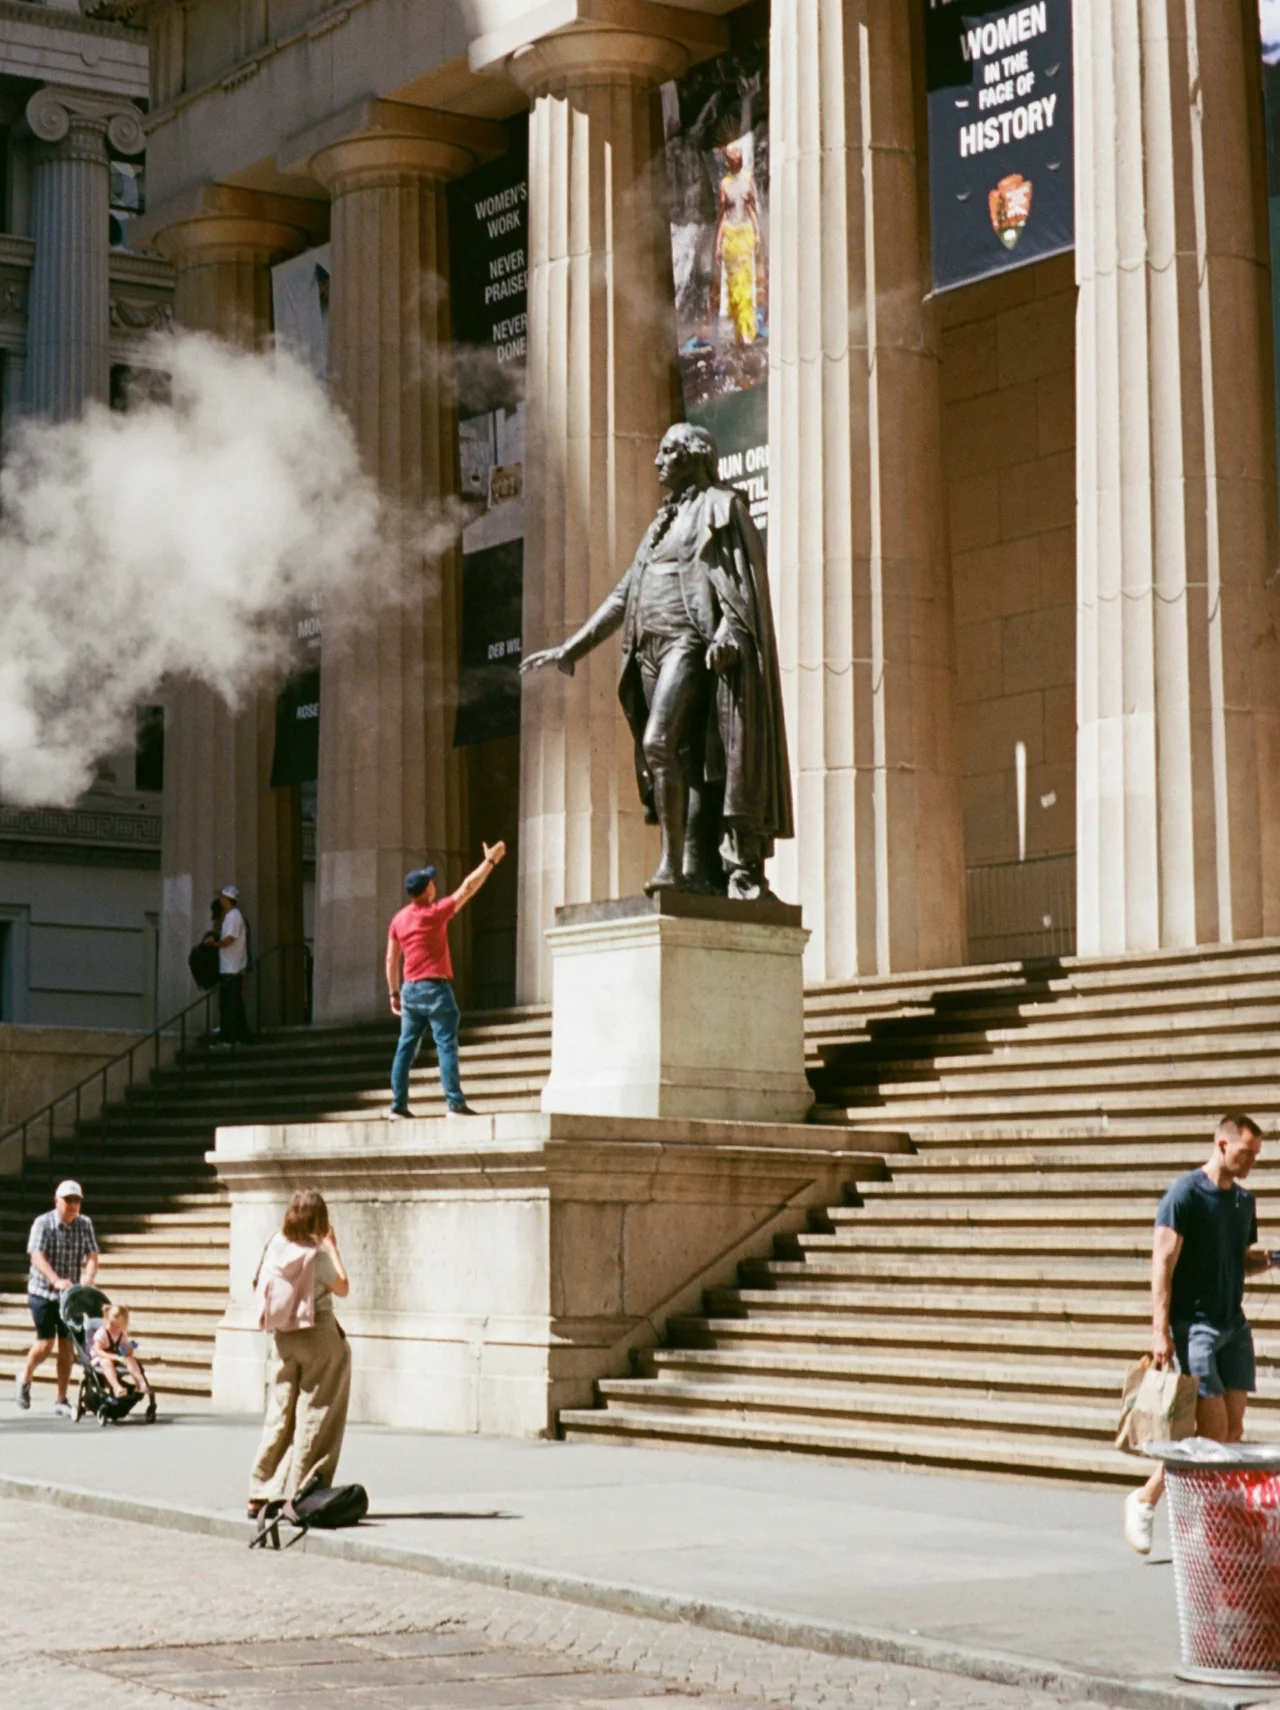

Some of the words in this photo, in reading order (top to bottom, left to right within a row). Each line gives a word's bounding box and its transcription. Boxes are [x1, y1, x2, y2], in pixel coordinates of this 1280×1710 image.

[959, 1, 1046, 61] WOMEN
[984, 61, 1001, 84] IN
[1001, 50, 1029, 78] THE
[978, 81, 1014, 110] FACE
[1016, 71, 1035, 96] OF
[959, 93, 1057, 158] HISTORY
[474, 181, 527, 220] WOMEN'S
[487, 210, 521, 239] WORK
[489, 248, 524, 280] NEVER
[492, 312, 527, 342] NEVER
[496, 337, 526, 365] DONE
[488, 641, 505, 660] DEB
